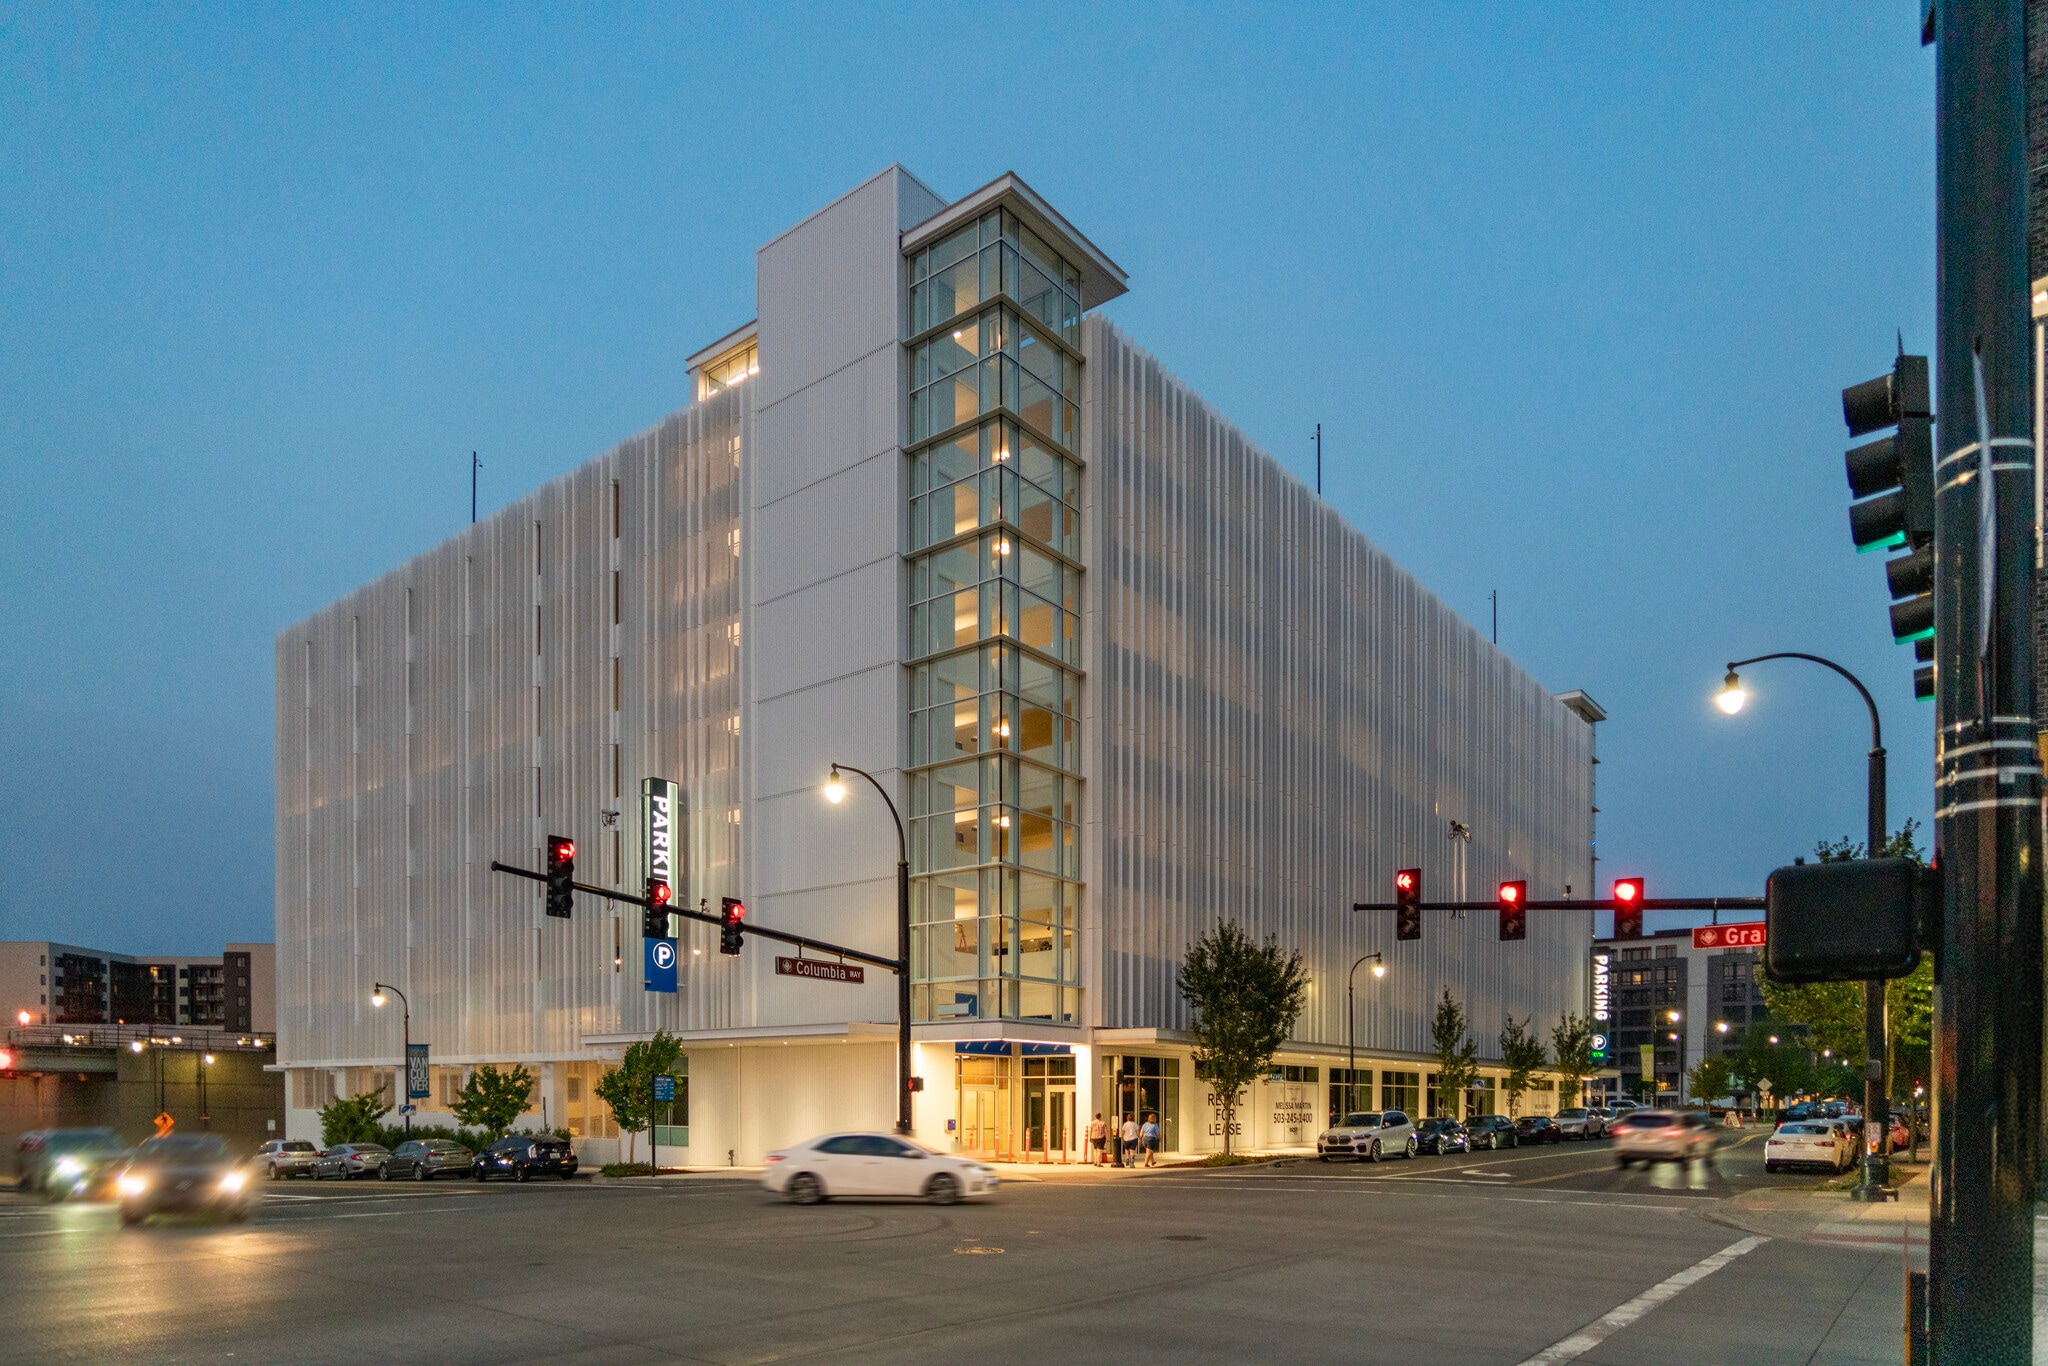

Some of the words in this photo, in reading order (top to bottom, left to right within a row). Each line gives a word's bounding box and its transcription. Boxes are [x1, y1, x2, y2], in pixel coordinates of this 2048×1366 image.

[652, 795, 669, 881] PARKI
[1726, 927, 1767, 945] Gra
[658, 946, 671, 965] P
[796, 961, 846, 979] Columbia
[849, 970, 861, 978] WAY
[1593, 955, 1609, 1021] PARKING
[410, 1057, 429, 1069] VAN
[411, 1069, 429, 1080] COU
[411, 1080, 429, 1091] VER
[1207, 1092, 1244, 1106] REAIL
